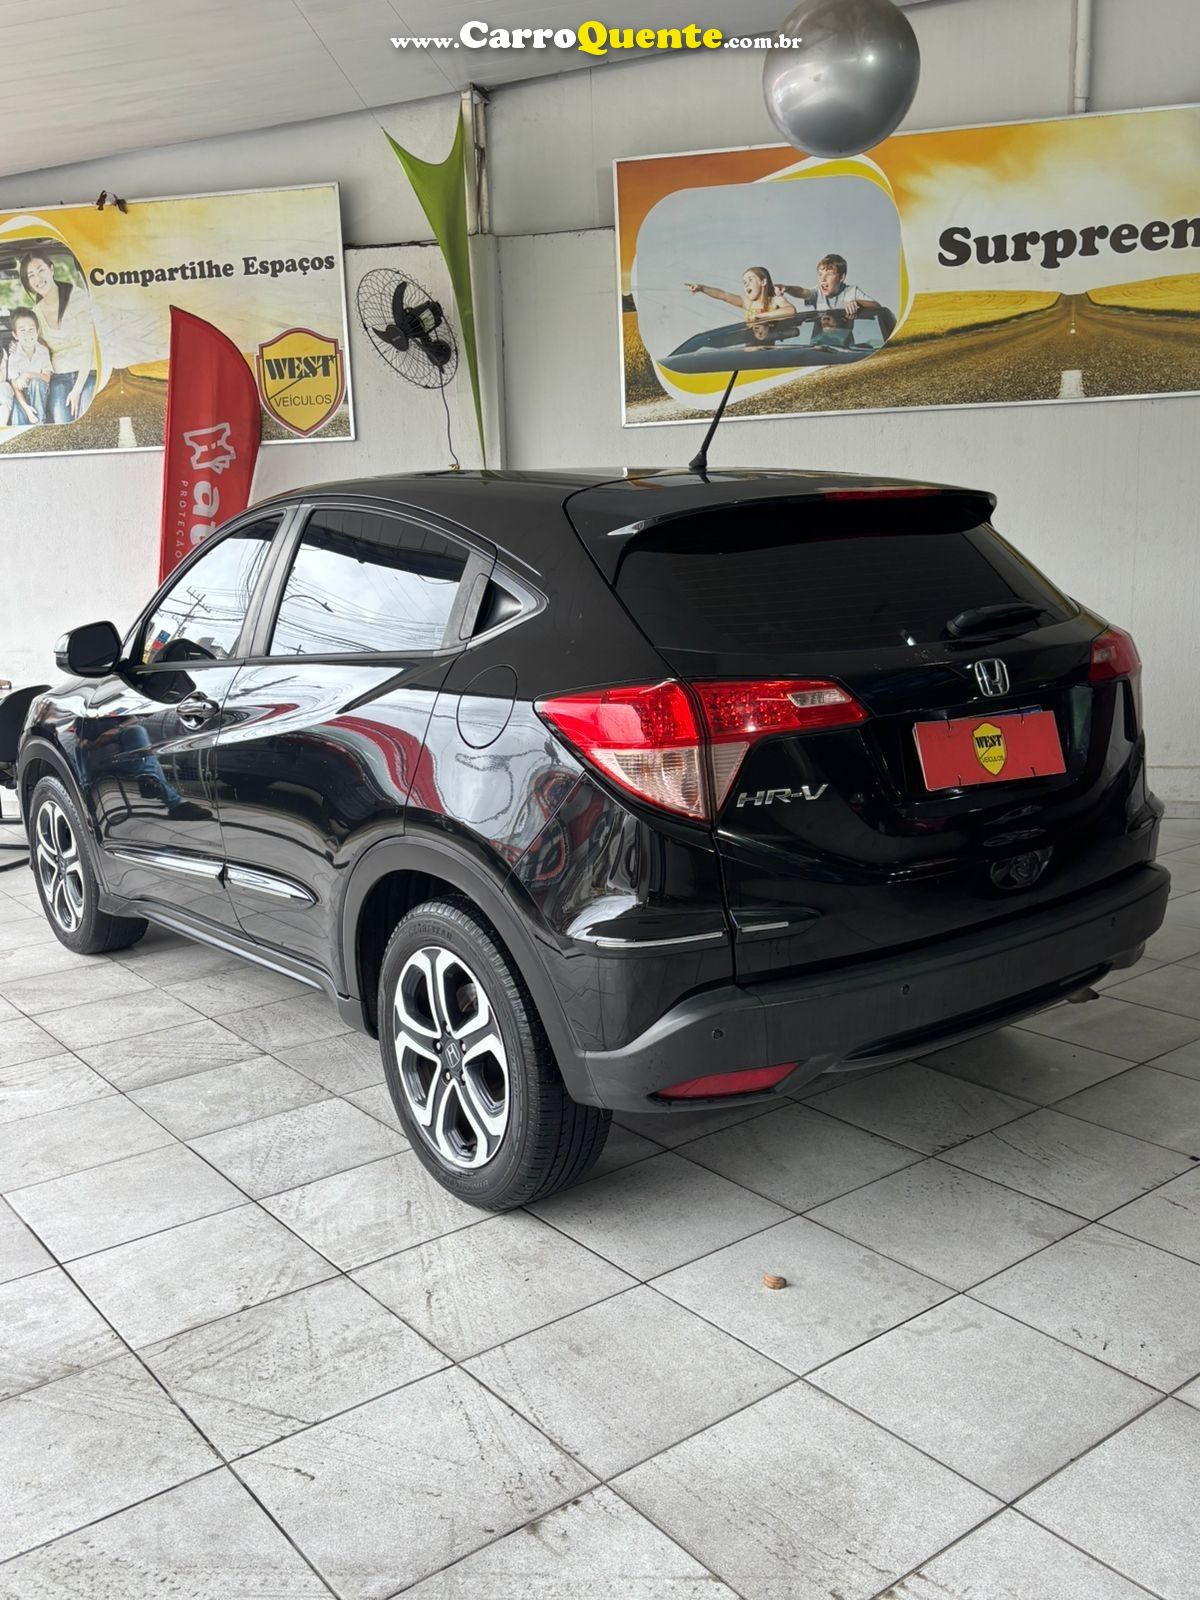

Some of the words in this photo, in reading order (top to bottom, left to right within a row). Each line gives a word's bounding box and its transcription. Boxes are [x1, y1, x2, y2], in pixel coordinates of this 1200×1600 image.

[89, 260, 234, 287] Compartilhe
[242, 255, 336, 277] Espaços
[265, 355, 335, 380] WEST
[274, 394, 332, 407] VEÍCULOS
[174, 480, 188, 559] PROTEÇÃO
[975, 734, 1003, 749] WEST
[736, 784, 828, 807] HR-V
